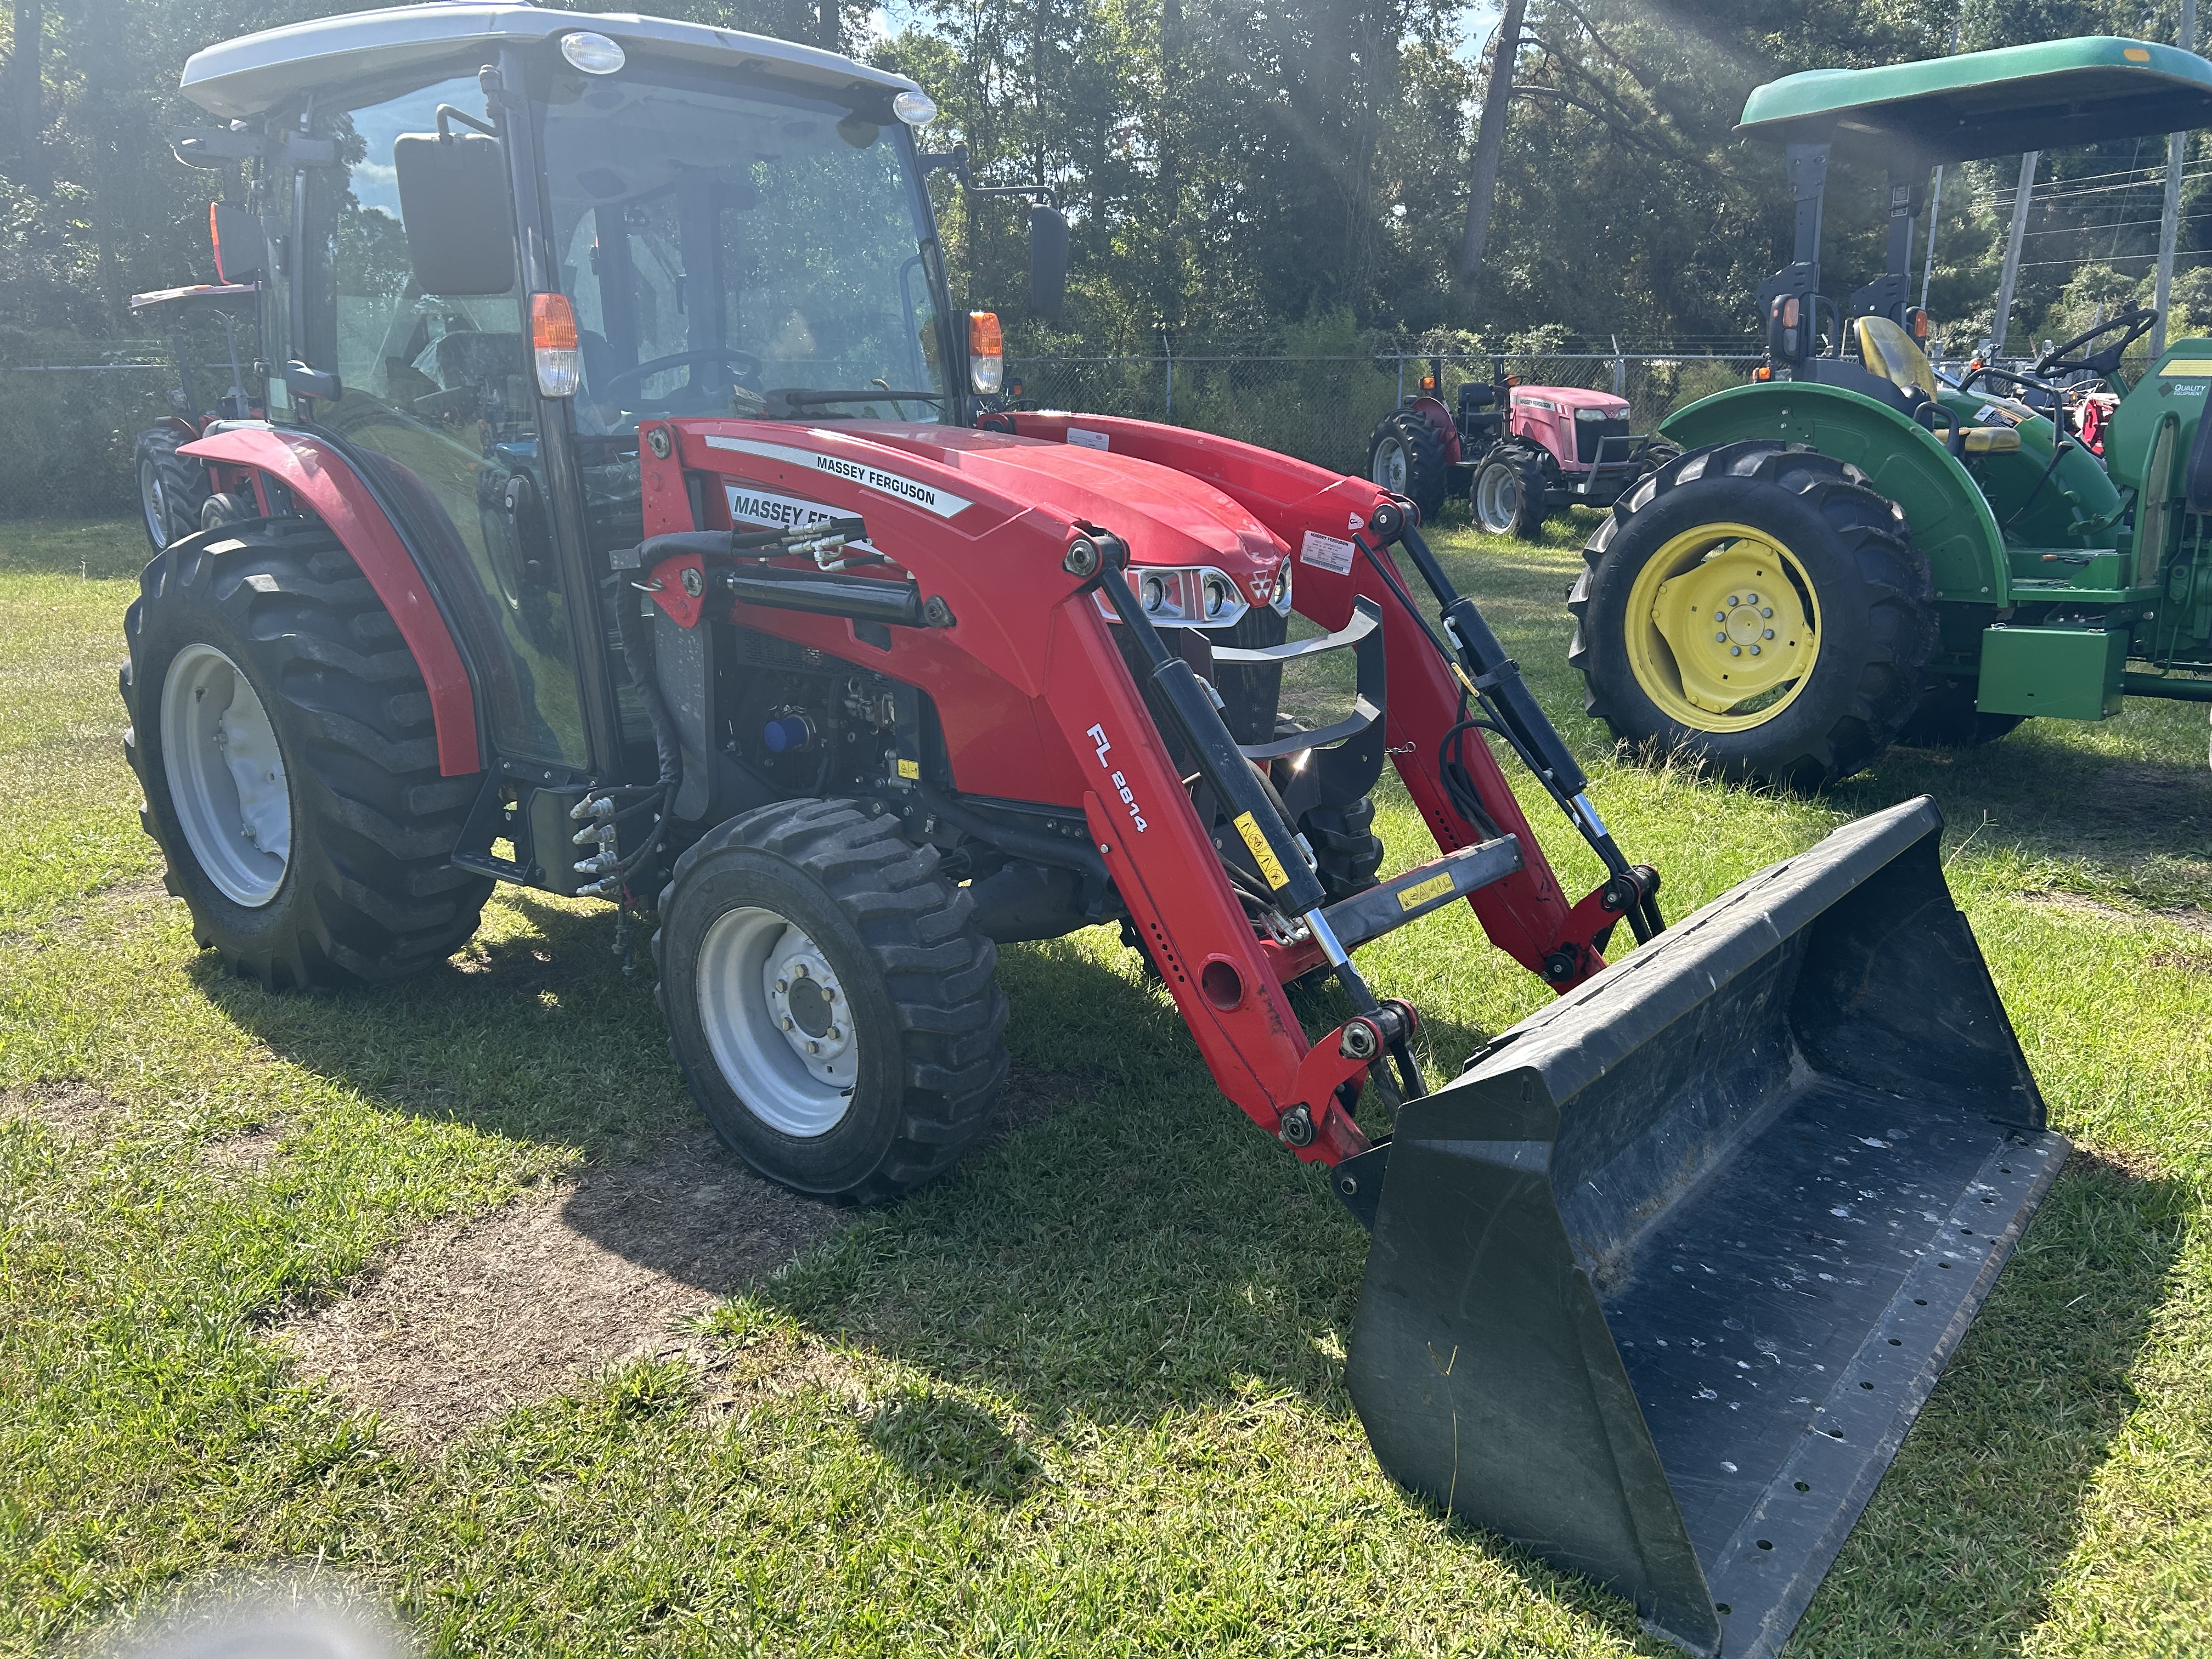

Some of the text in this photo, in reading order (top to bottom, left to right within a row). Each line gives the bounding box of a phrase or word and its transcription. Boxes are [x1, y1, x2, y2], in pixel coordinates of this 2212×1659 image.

[817, 456, 935, 506] MASSEY FERGUSON
[734, 495, 804, 525] MASSEY
[1310, 532, 1349, 546] MASSEY FERGUSON
[1086, 722, 1148, 833] FL 2814
